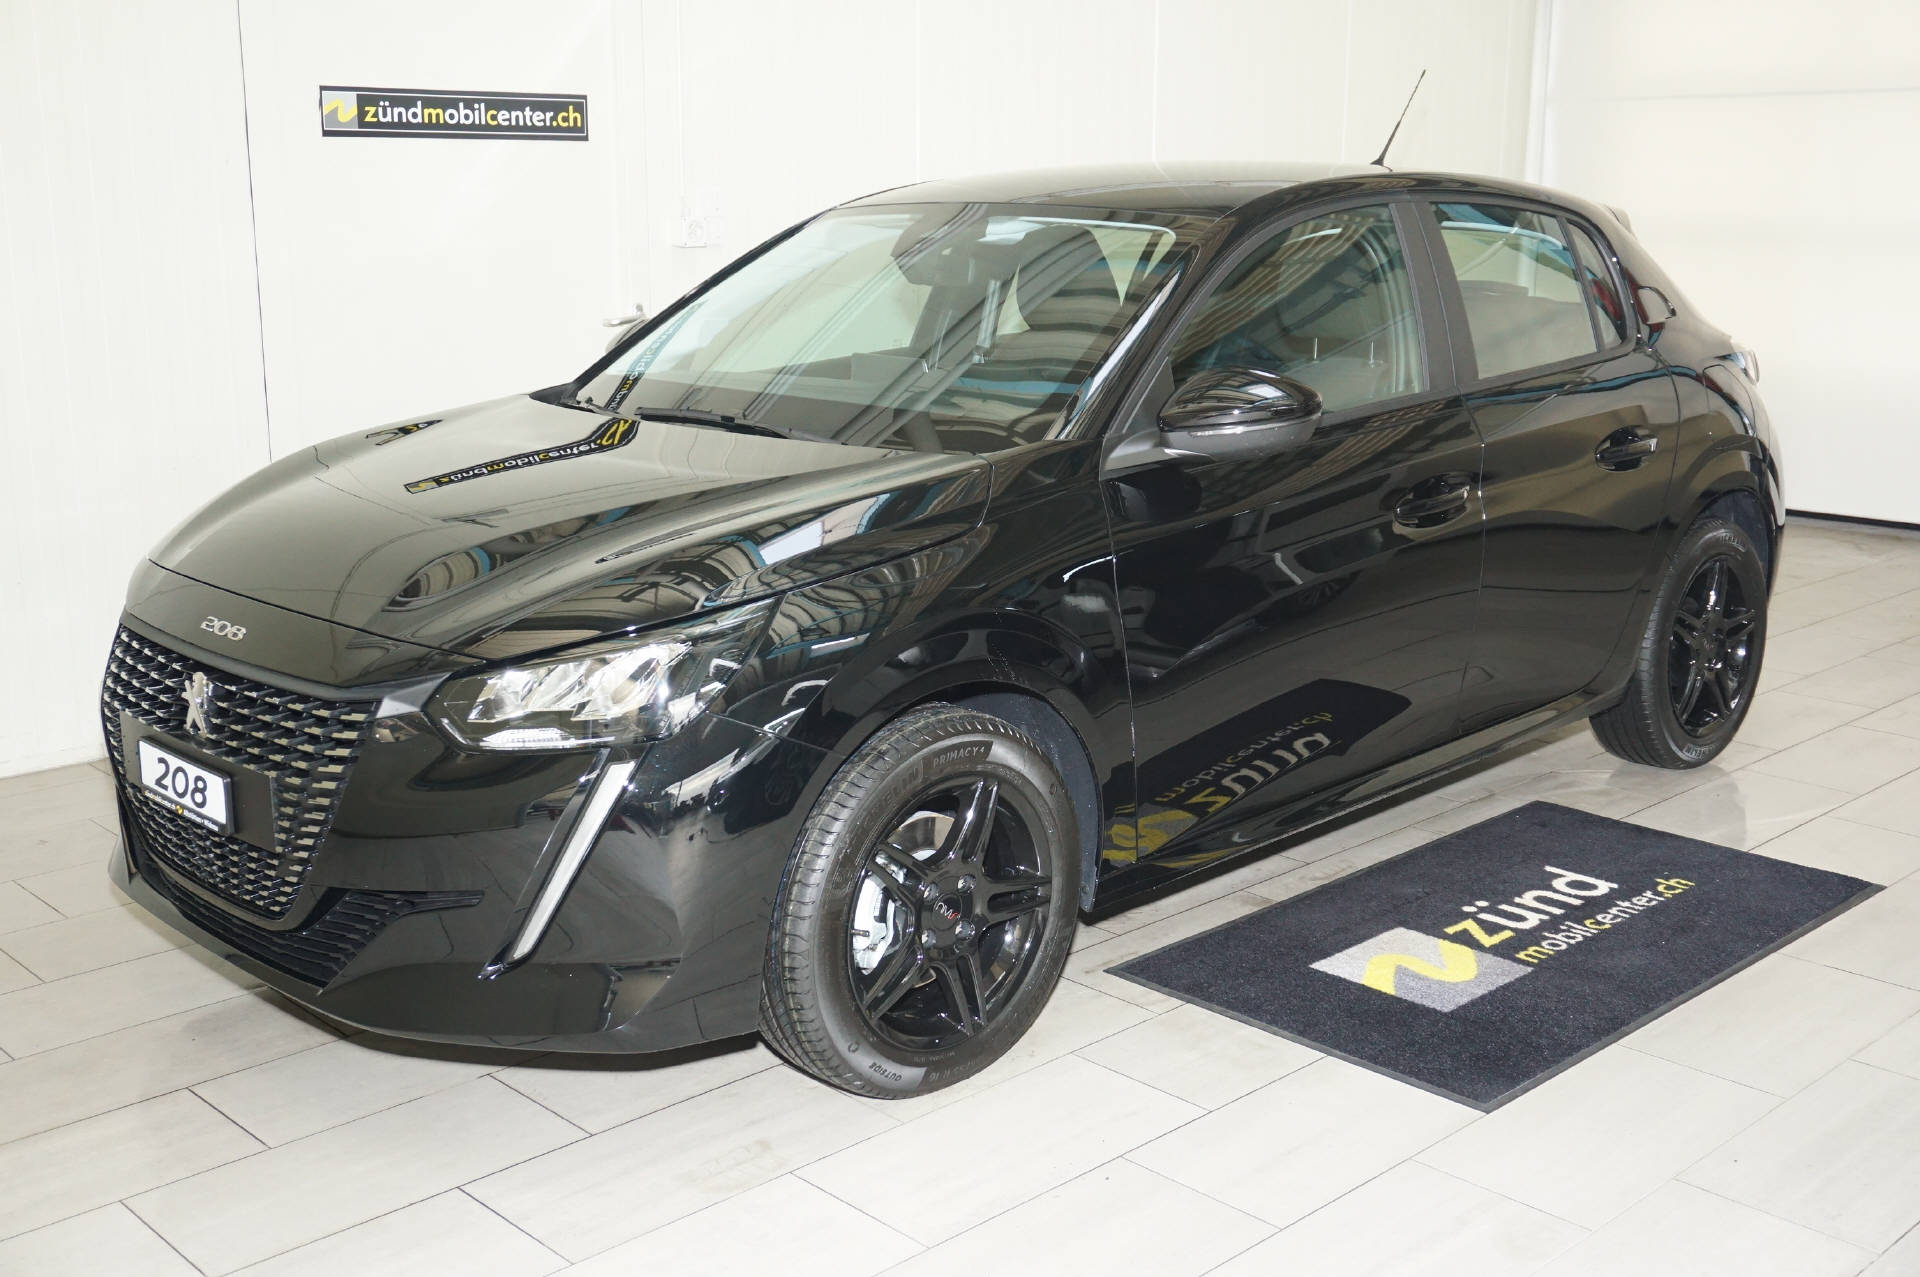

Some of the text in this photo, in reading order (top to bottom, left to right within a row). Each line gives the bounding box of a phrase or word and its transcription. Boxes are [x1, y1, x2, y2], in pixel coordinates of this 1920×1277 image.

[364, 100, 582, 128] zündmobilcenter.ch
[199, 615, 247, 642] 208
[933, 746, 979, 769] PRIMACY
[154, 757, 208, 809] 208
[1443, 865, 1619, 948] zünd
[1515, 877, 1696, 964] mobilcenter.ch
[868, 1061, 903, 1082] OUTSIDE
